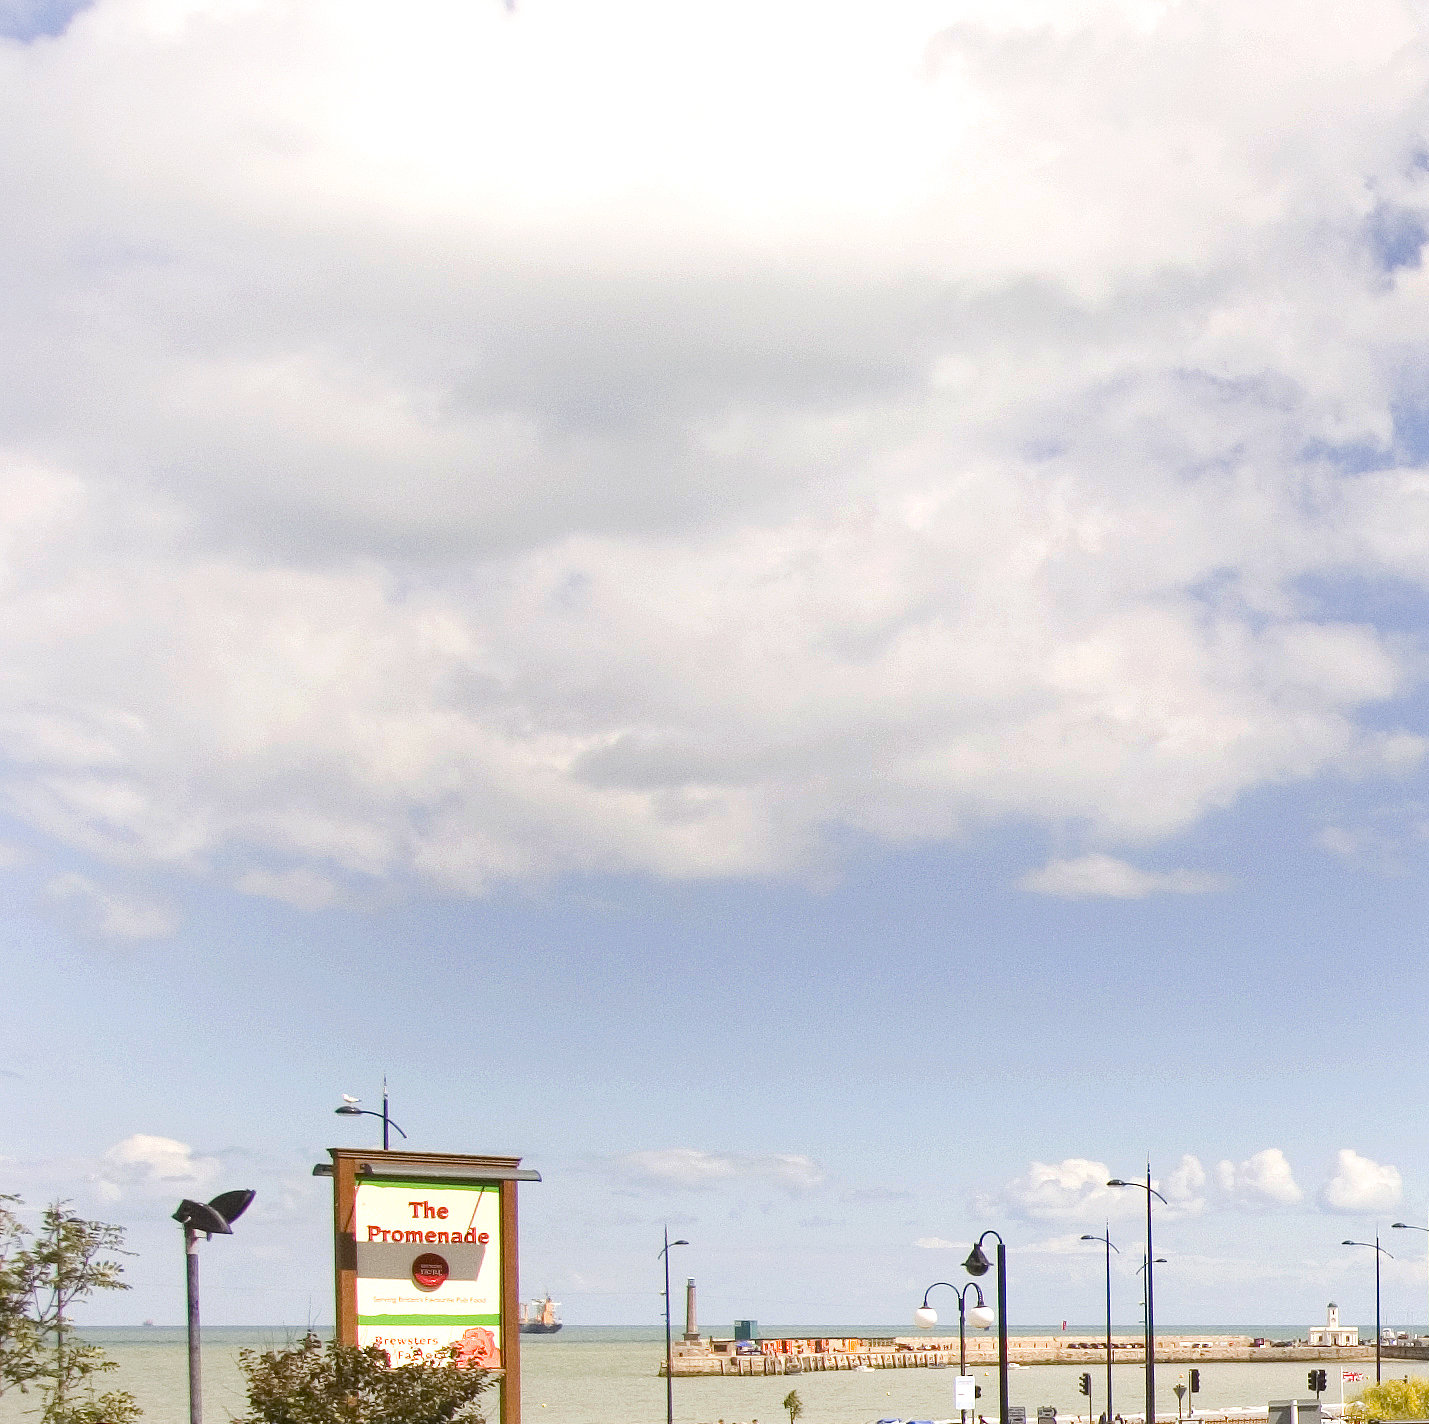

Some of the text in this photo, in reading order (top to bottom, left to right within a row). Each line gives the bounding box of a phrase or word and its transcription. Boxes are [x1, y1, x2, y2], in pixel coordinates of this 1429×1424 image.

[408, 1201, 449, 1219] The
[367, 1225, 490, 1245] Promenade
[375, 1335, 439, 1346] Brewsters
